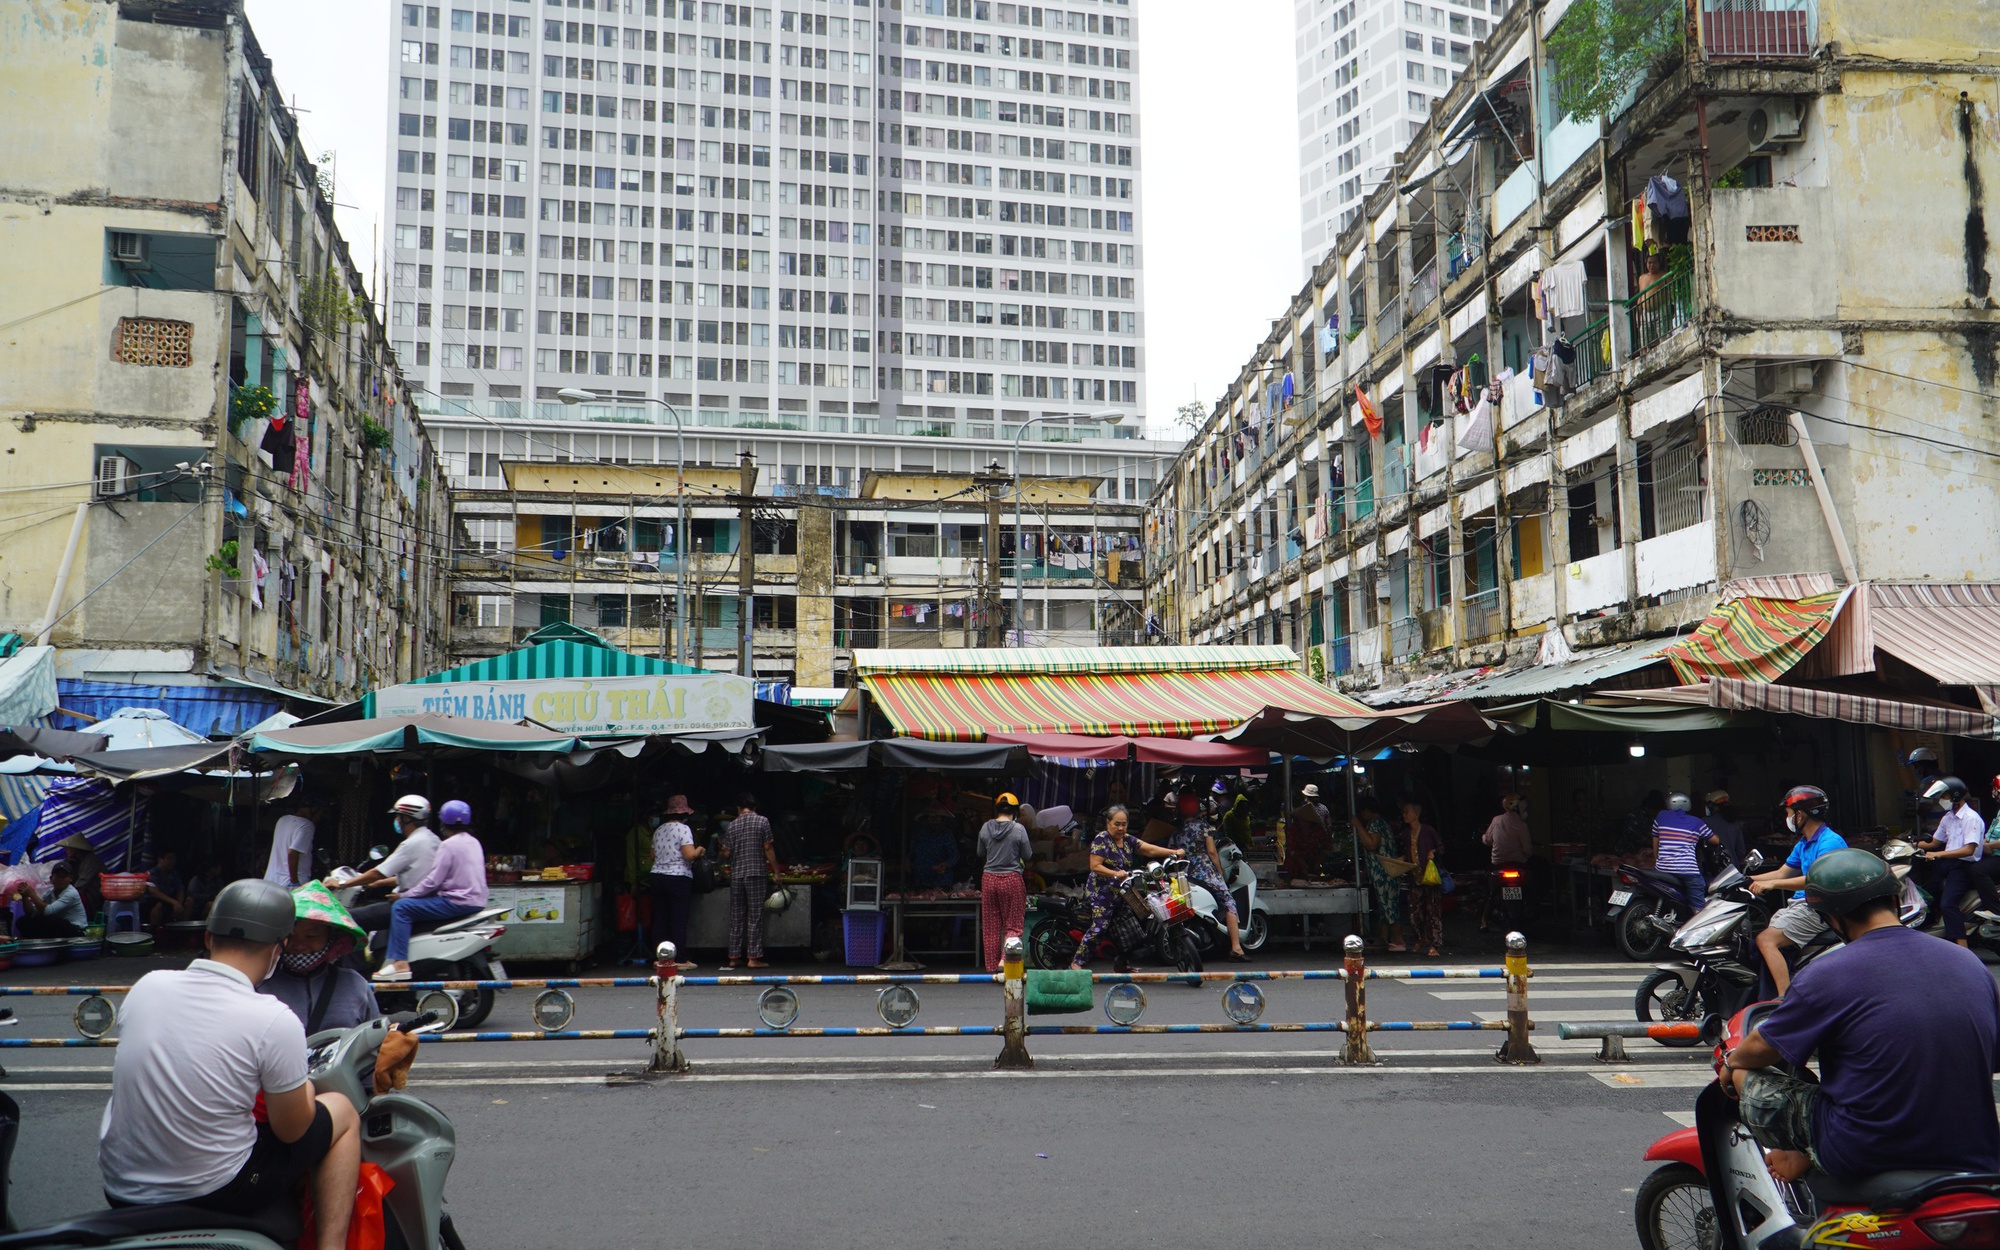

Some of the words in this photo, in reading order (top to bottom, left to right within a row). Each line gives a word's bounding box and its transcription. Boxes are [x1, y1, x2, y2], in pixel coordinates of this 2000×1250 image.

[473, 686, 526, 721] BÁNH
[532, 681, 599, 722] CHỦ
[606, 679, 686, 721] THÁI
[1730, 1168, 1757, 1180] HONDA
[145, 1234, 217, 1242] VISION
